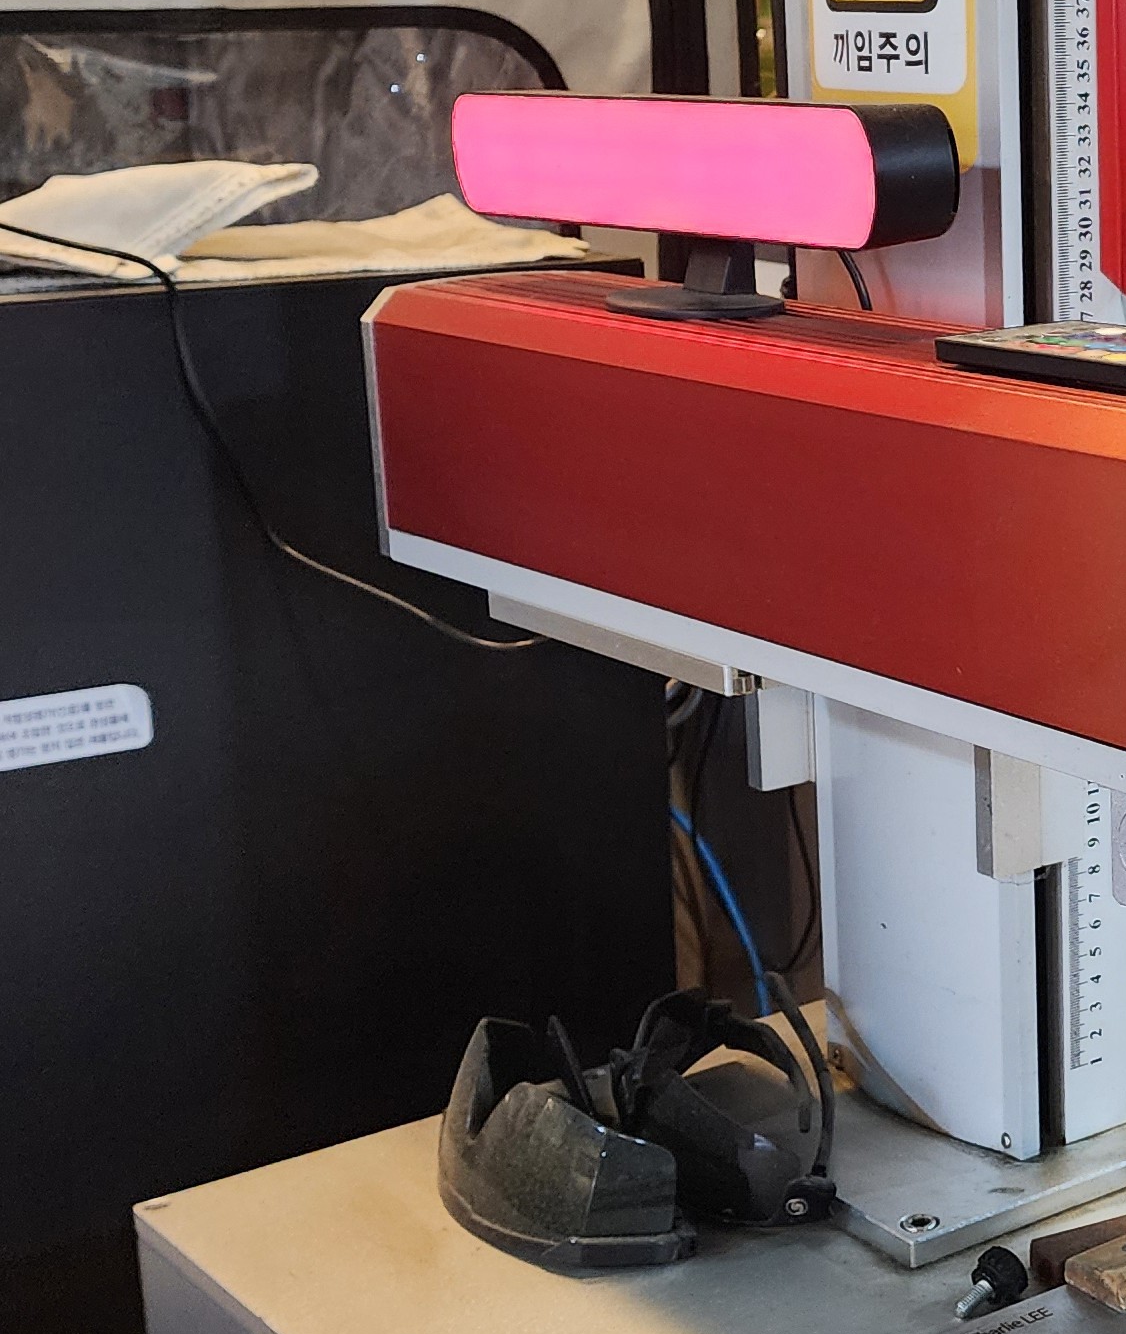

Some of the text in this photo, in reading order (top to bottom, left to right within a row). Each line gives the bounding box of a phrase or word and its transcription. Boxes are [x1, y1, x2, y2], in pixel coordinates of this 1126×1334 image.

[1077, 28, 1089, 50] 36
[832, 29, 929, 74] 끼임주의
[1077, 60, 1089, 82] 35
[1078, 92, 1090, 113] 34
[1078, 125, 1090, 145] 33
[1078, 156, 1090, 177] 32
[1079, 190, 1091, 209] 31
[1079, 217, 1092, 241] 30
[1080, 250, 1092, 271] 29
[1080, 281, 1092, 301] 28
[1087, 803, 1100, 824] 10
[1088, 838, 1099, 847] 9
[1089, 865, 1100, 874] 8
[1089, 894, 1099, 902] 7
[1090, 920, 1100, 929] 6
[1090, 947, 1101, 956] 5
[1090, 975, 1101, 983] 4
[1090, 1002, 1101, 1011] 3
[1090, 1029, 1101, 1039] 2
[1020, 1306, 1054, 1326] LEE
